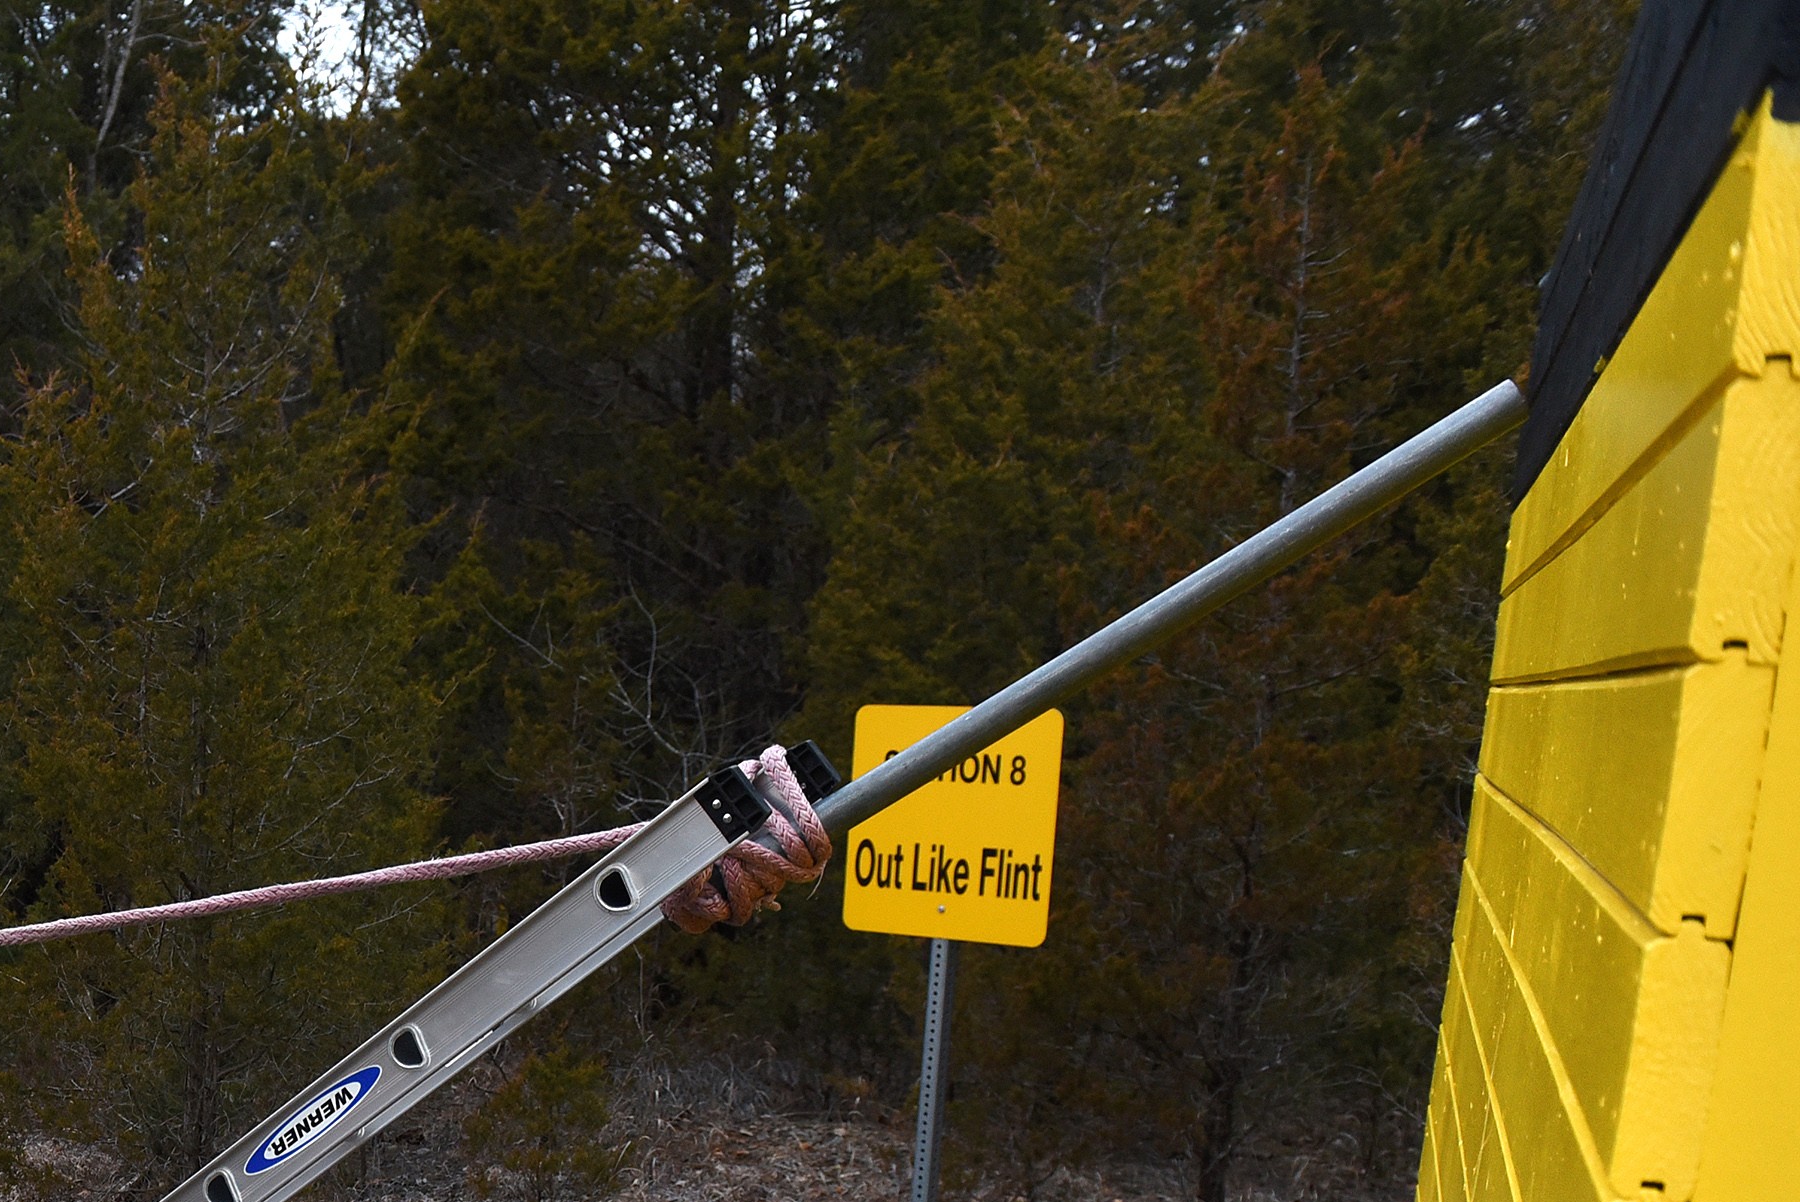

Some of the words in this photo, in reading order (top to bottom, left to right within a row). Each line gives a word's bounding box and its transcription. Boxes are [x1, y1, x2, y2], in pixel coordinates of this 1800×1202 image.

[1010, 755, 1027, 786] 8
[854, 838, 903, 890] Out
[911, 842, 970, 896] Like
[978, 847, 1043, 902] Flint
[270, 1086, 354, 1157] WERNER
